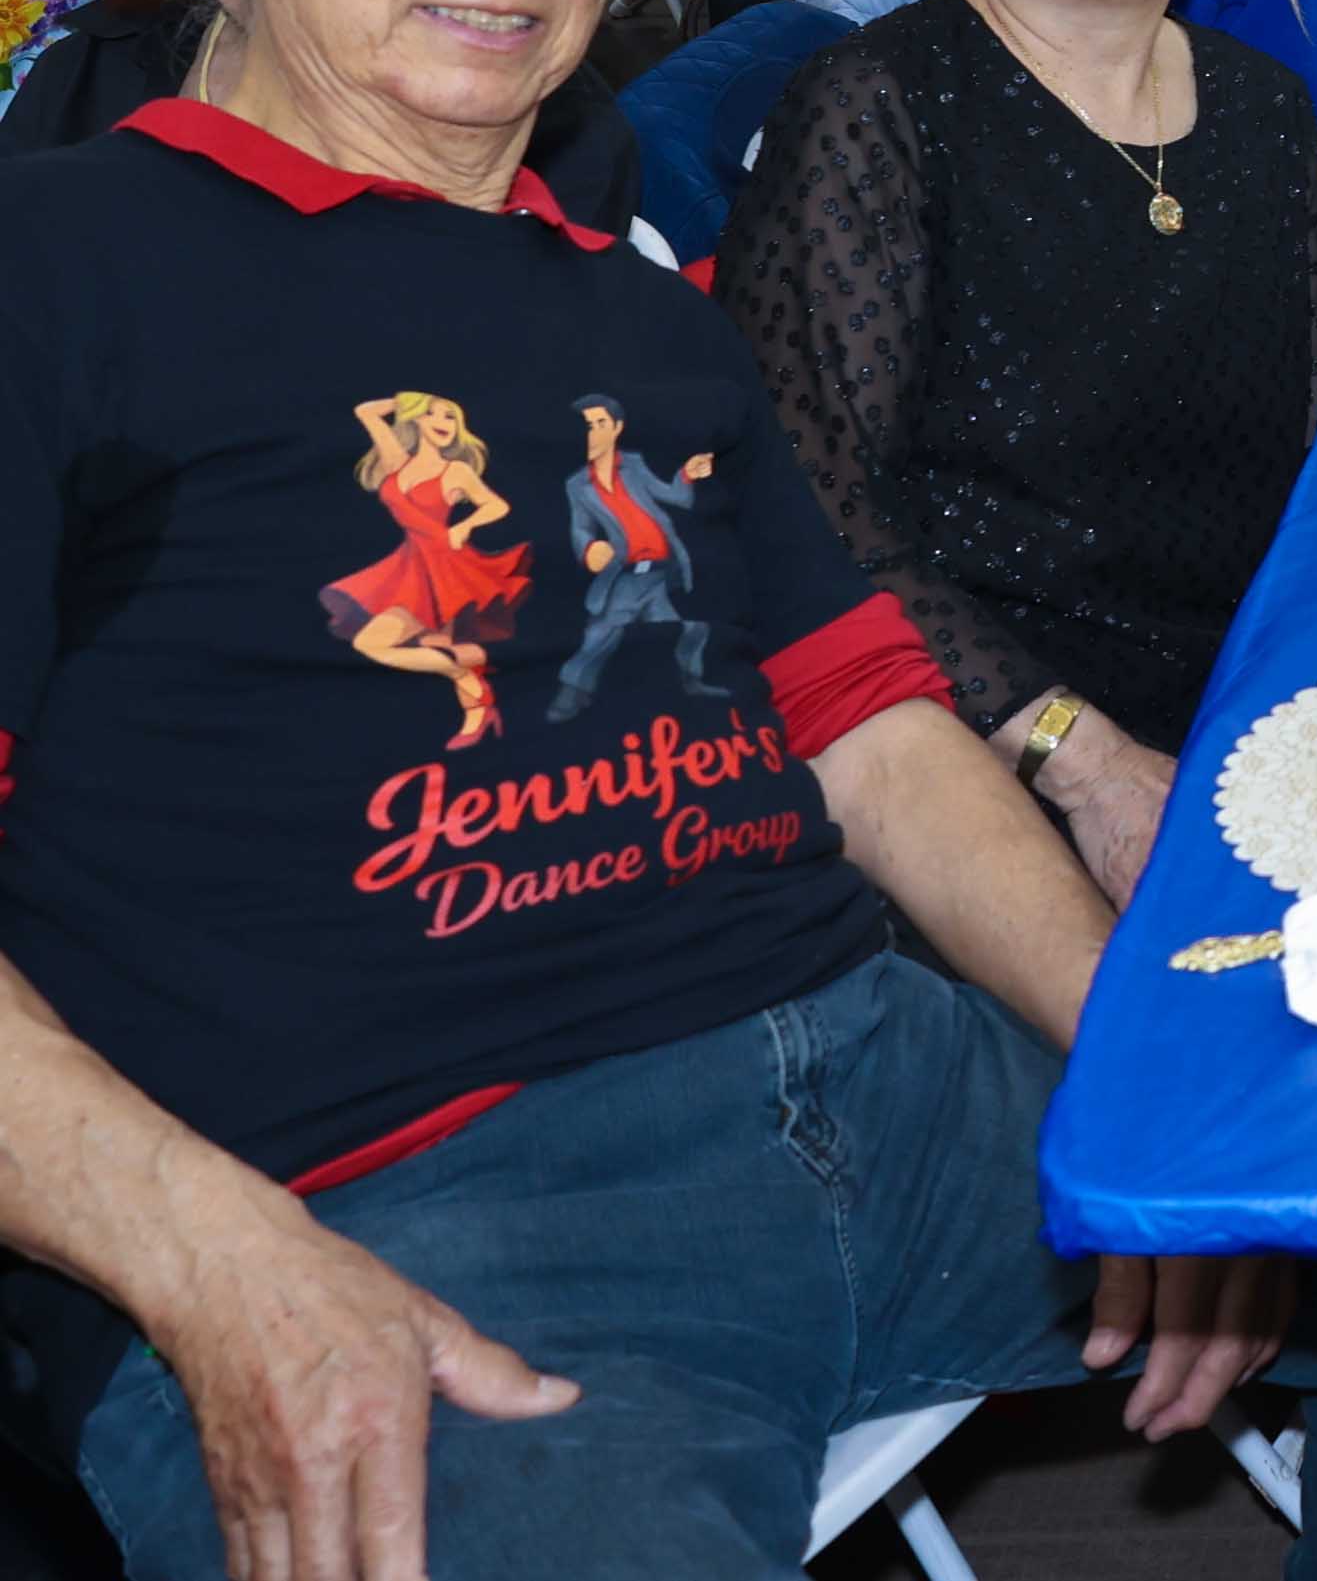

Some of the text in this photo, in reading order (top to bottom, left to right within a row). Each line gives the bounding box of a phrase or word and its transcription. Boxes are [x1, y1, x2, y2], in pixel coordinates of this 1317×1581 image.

[354, 709, 783, 892] Jennifer's
[414, 805, 800, 938] Dance Group
